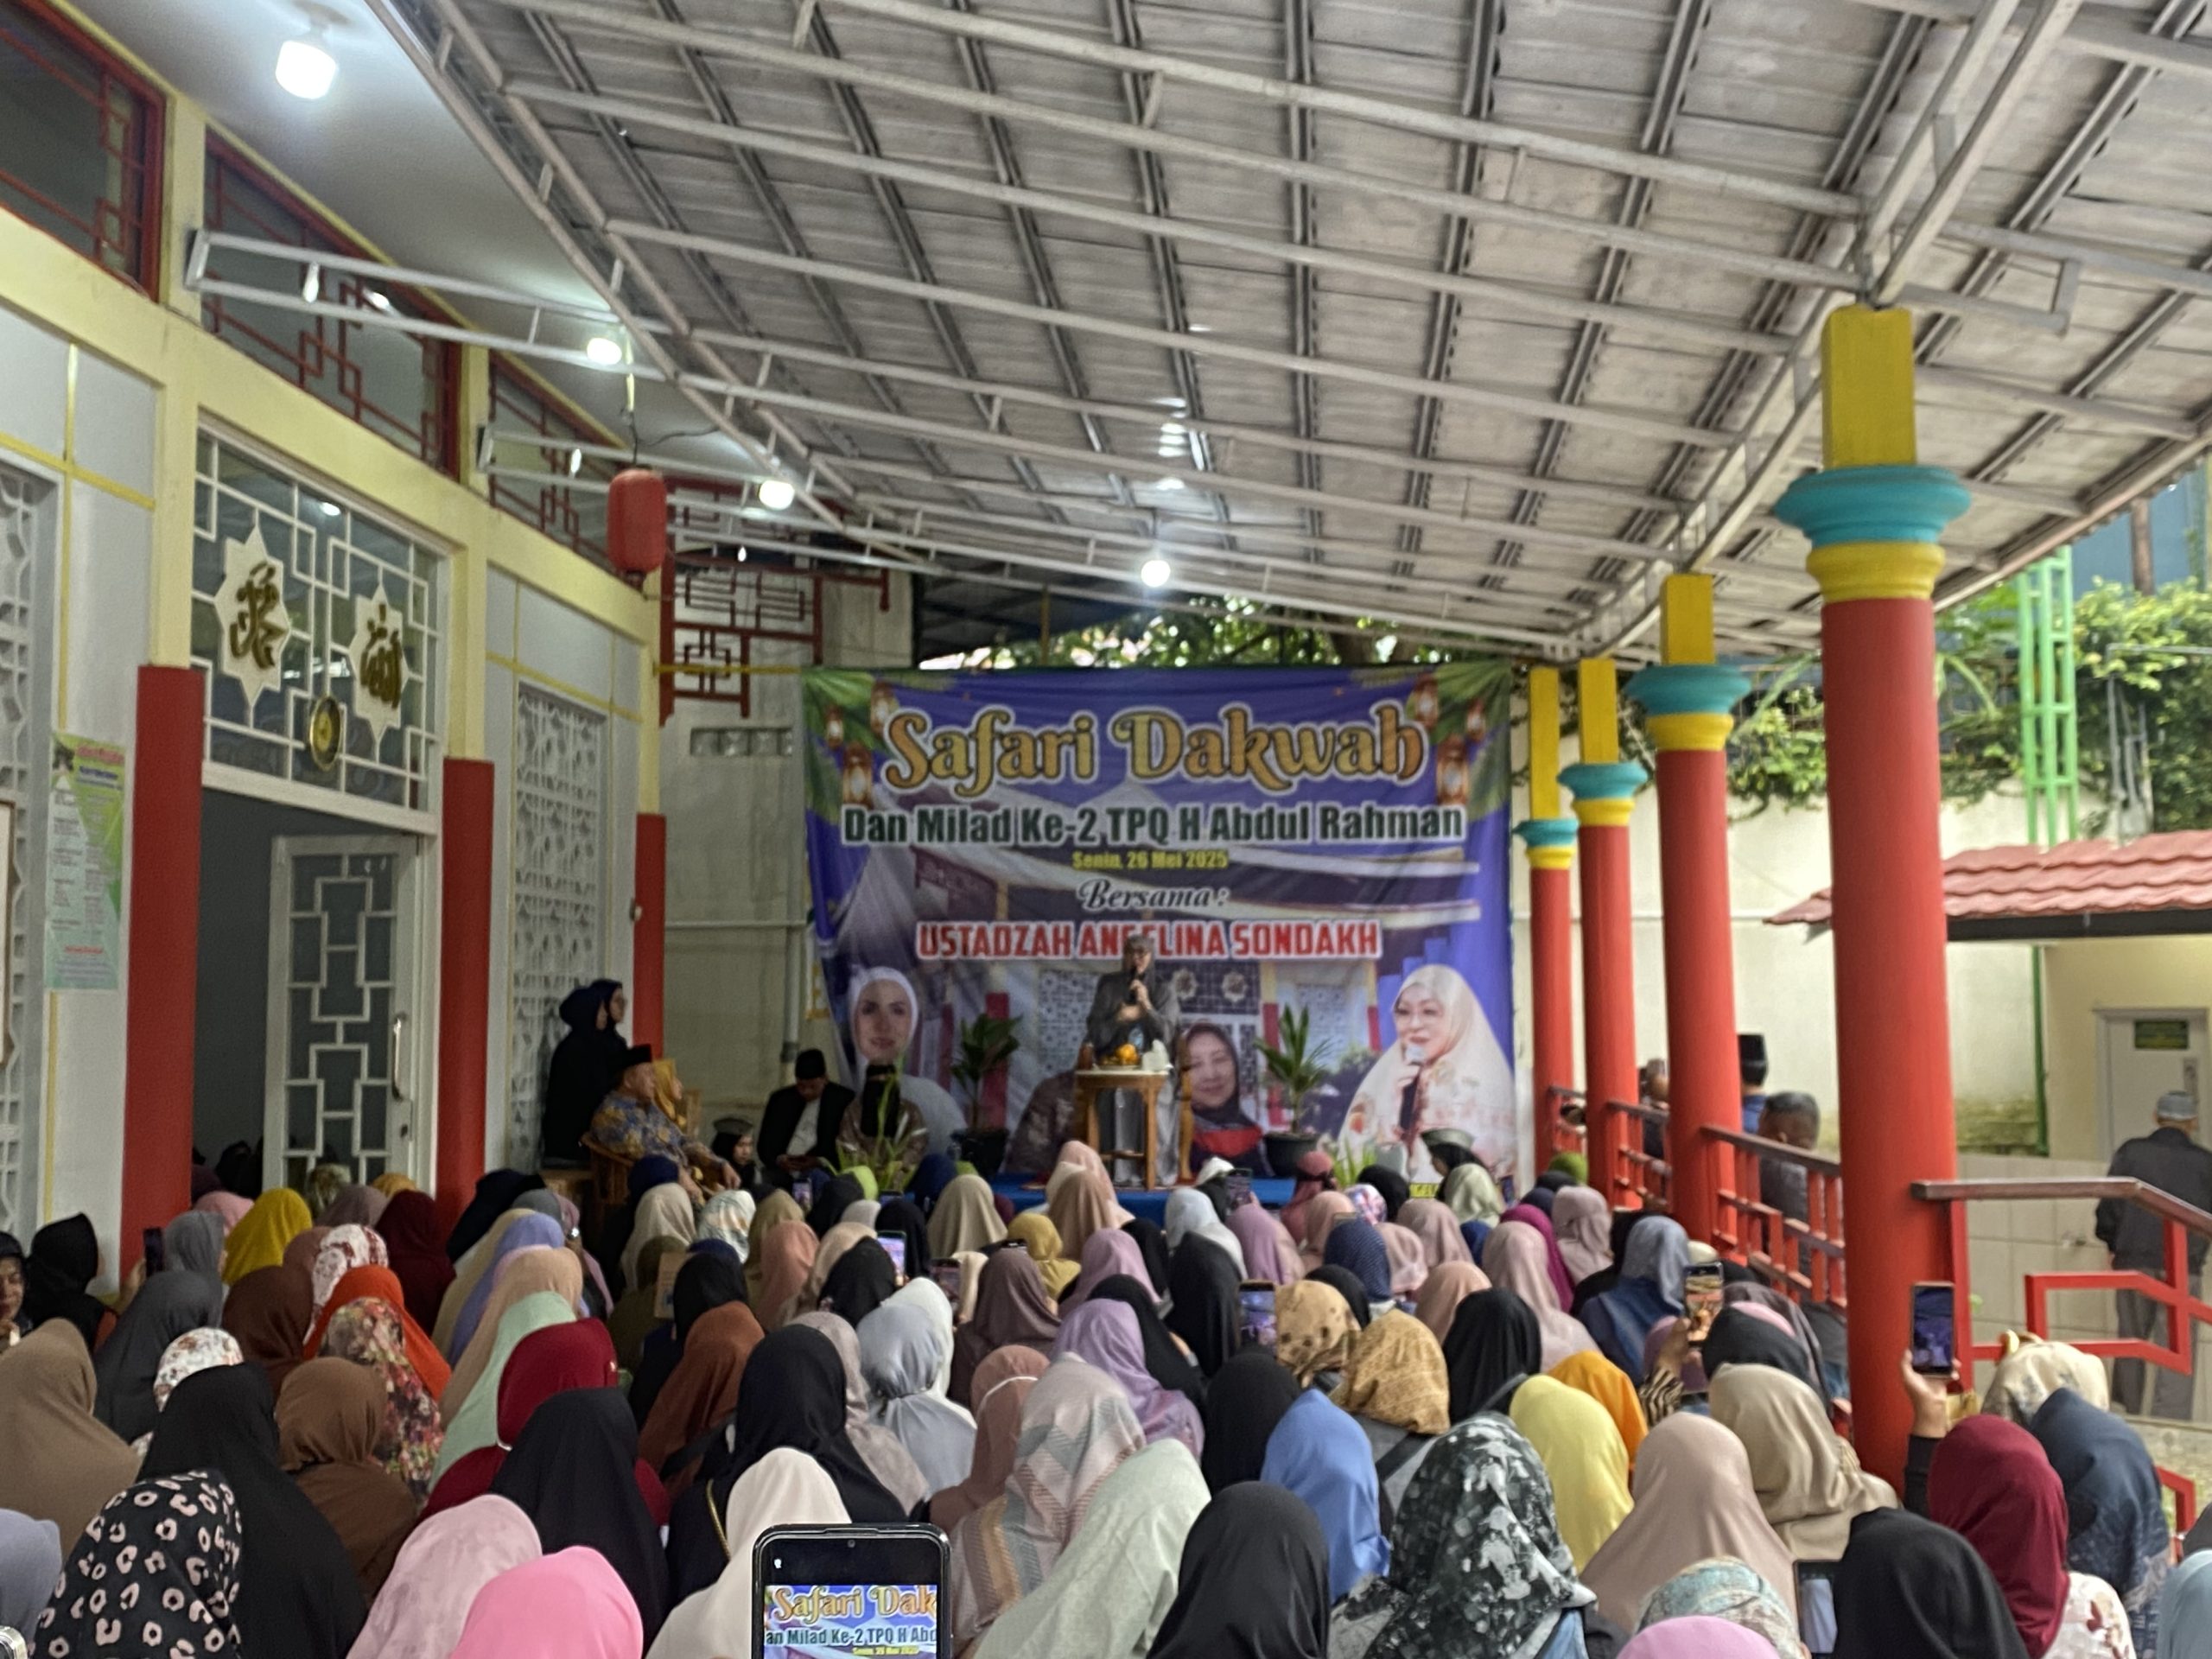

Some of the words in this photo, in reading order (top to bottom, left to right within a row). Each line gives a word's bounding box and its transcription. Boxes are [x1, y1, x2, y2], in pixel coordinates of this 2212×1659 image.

[885, 709, 1095, 798] Safari
[1111, 706, 1424, 790] Dakwah
[843, 807, 907, 843] Dan
[916, 807, 1012, 843] Milad
[1020, 807, 1097, 843] Ke-2
[1106, 806, 1168, 845] TPQ
[1179, 805, 1202, 842] H
[1209, 805, 1310, 841] Abdul
[1319, 804, 1463, 841] Rahman
[1126, 849, 1149, 869] 26
[1185, 849, 1228, 869] 2025
[918, 923, 1071, 957] USTADZAH
[1230, 921, 1379, 957] SONDAKH
[774, 1585, 863, 1625] Safari
[867, 1585, 937, 1618] Dak
[766, 1630, 783, 1645] an
[787, 1628, 827, 1643] Milad
[831, 1628, 864, 1643] Ke-2
[898, 1628, 907, 1643] H
